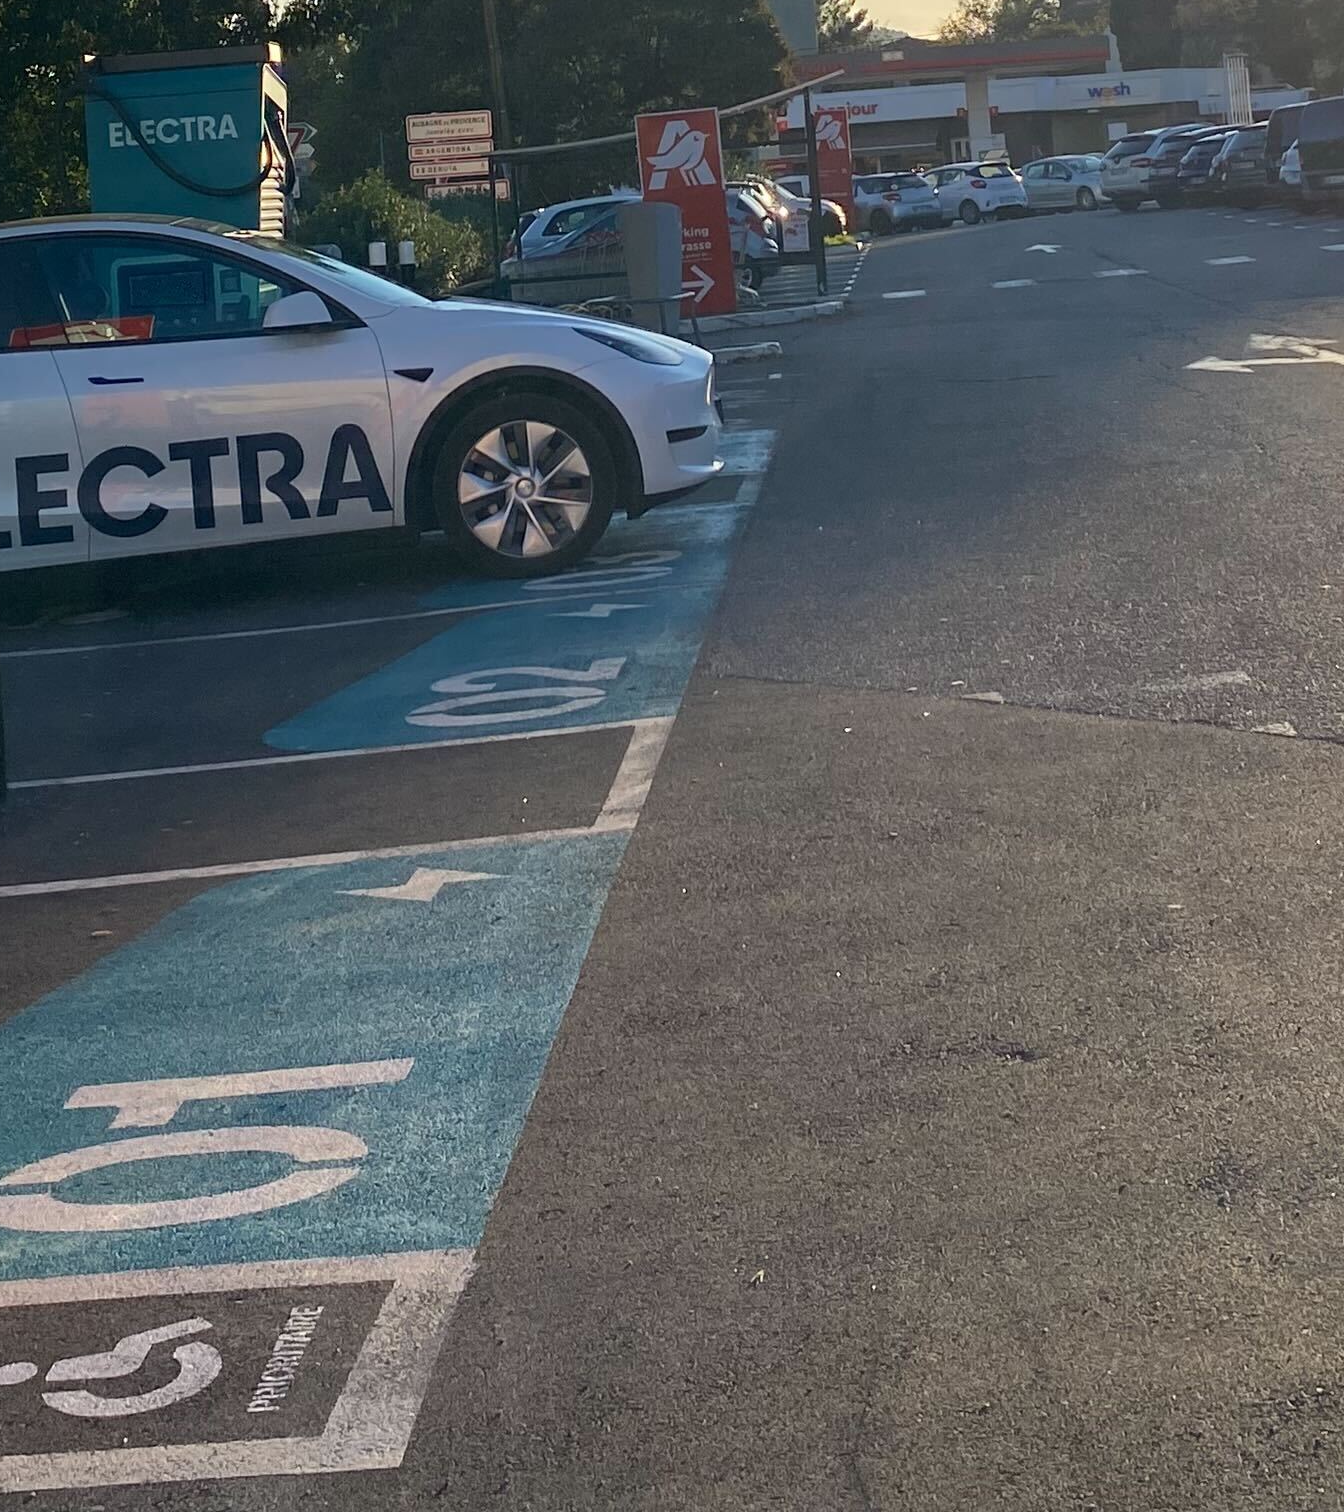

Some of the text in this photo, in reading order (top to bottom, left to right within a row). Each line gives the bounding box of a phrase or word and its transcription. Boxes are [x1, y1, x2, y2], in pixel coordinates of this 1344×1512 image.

[817, 101, 878, 119] jour
[682, 227, 709, 238] king
[405, 656, 628, 727] 02
[247, 1304, 324, 1414] PRIORITAIRE
